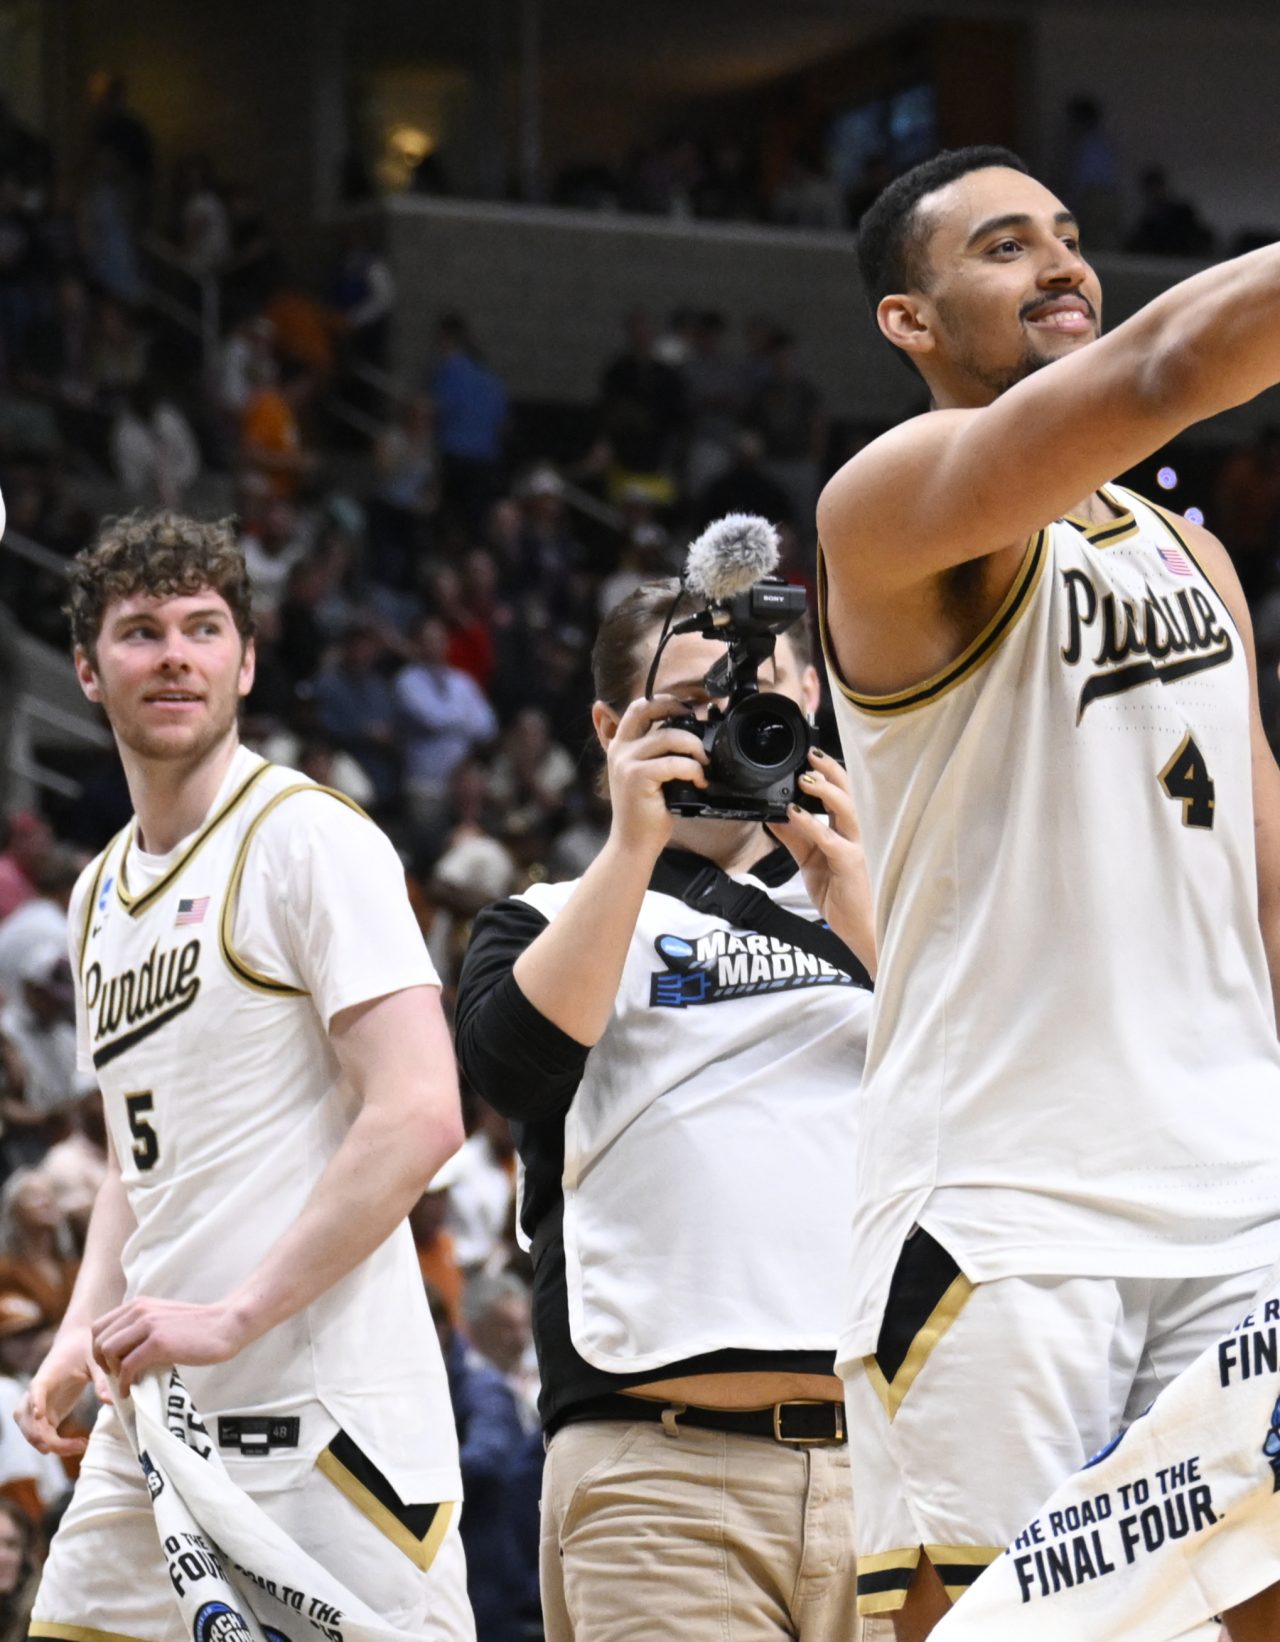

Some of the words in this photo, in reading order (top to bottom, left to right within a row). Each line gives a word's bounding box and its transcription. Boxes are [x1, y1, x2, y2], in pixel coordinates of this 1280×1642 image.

[763, 594, 785, 602] SONY
[1157, 729, 1216, 831] 4
[696, 931, 804, 962] MARC
[124, 1089, 160, 1172] 5
[1048, 1493, 1113, 1538] ROAD
[1117, 1478, 1150, 1512] TO
[1155, 1455, 1202, 1496] THE
[1013, 1529, 1116, 1604] FINAL
[1118, 1484, 1226, 1565] FOUR.
[309, 1598, 346, 1627] THE
